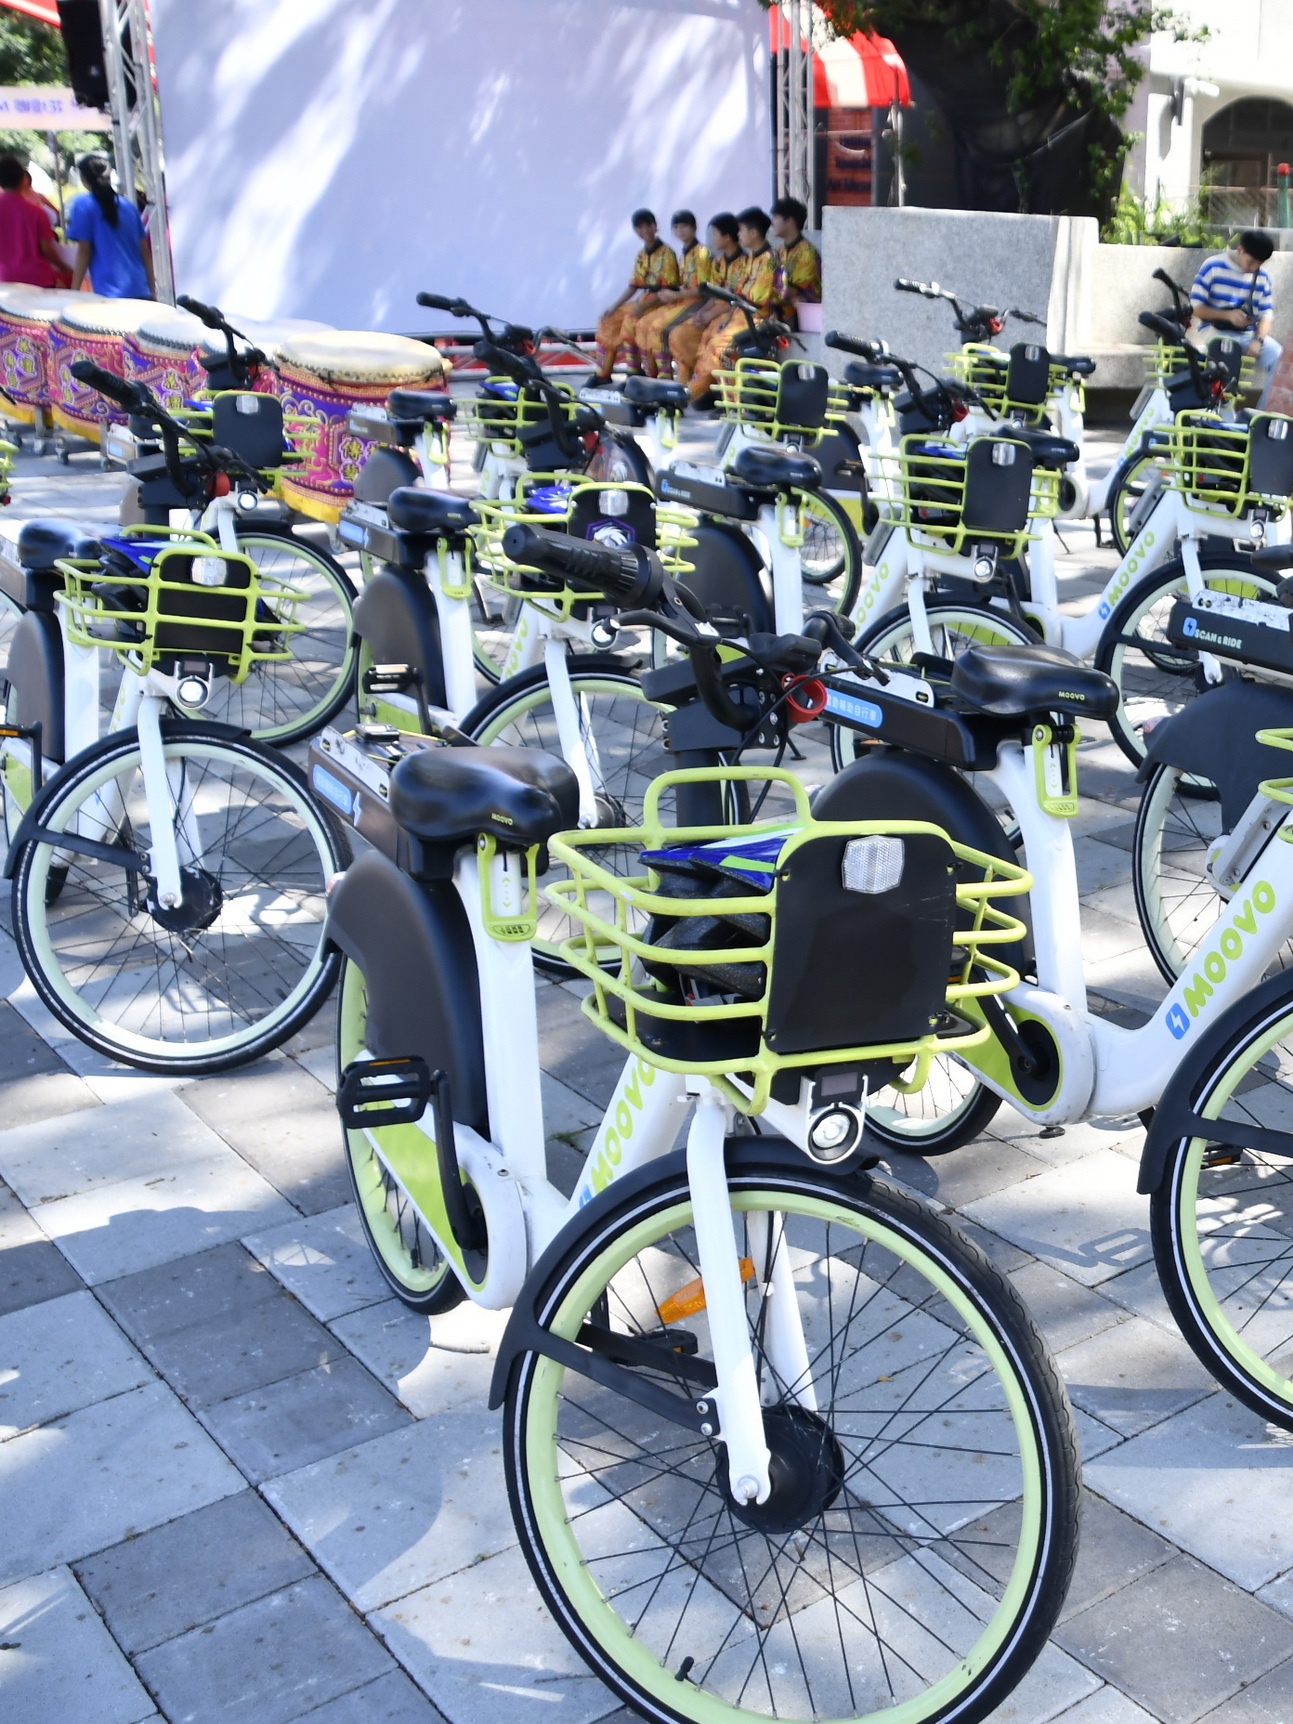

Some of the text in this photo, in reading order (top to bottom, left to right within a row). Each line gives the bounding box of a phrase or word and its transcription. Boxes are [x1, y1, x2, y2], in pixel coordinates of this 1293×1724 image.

[1108, 531, 1155, 607] MOOVO
[1195, 628, 1217, 643] SCAN
[1223, 635, 1242, 649] RIDE
[1059, 690, 1086, 701] MOOVO
[491, 811, 515, 826] MOOVO
[1183, 880, 1276, 1018] MOOVO
[591, 1057, 656, 1196] MOOVO
